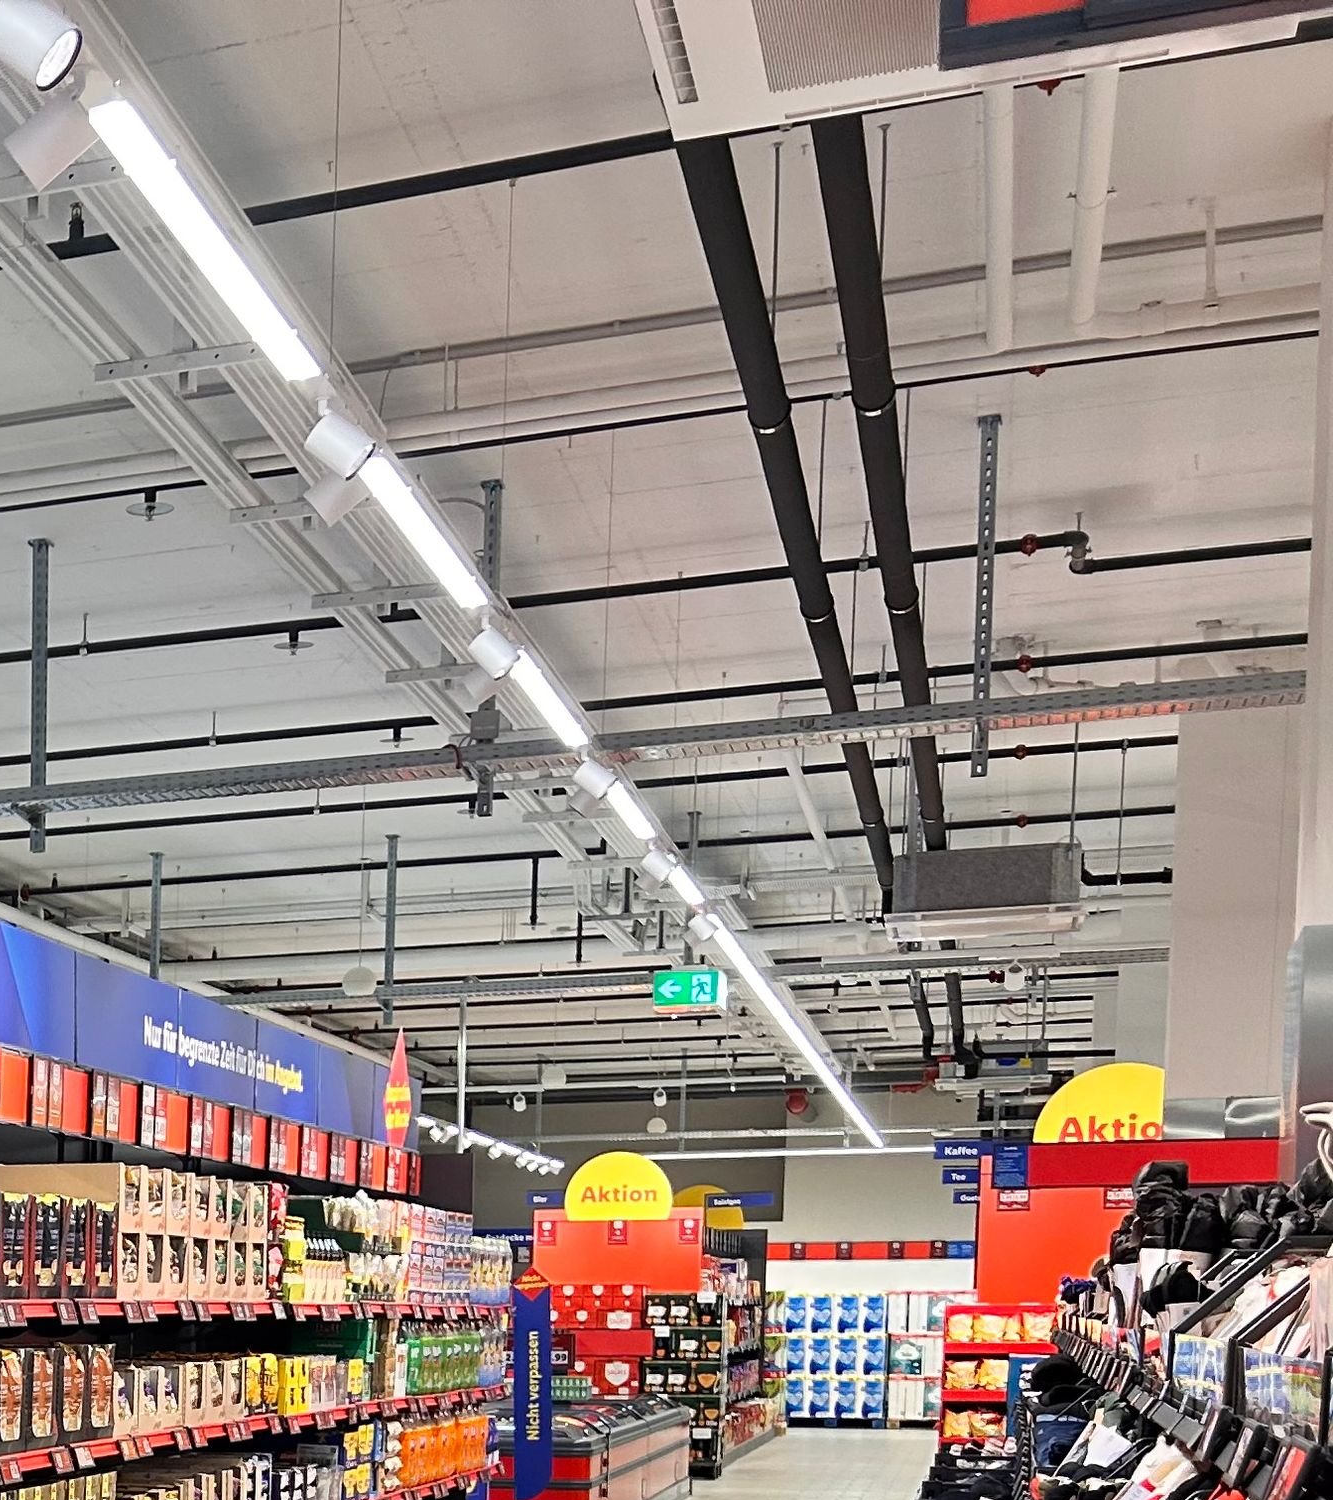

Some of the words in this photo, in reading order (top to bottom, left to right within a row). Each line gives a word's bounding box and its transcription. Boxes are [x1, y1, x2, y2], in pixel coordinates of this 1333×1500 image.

[143, 1015, 163, 1049] Nur
[163, 1020, 178, 1053] für
[178, 1025, 220, 1068] begrenzte
[220, 1041, 235, 1072] Zeit
[235, 1049, 248, 1073] für
[248, 1049, 266, 1079] Dich
[1059, 1113, 1162, 1144] Aktio
[944, 1146, 978, 1157] Kaffee
[951, 1172, 966, 1181] Tee
[581, 1184, 658, 1204] Aktion
[528, 1330, 542, 1401] verpassen
[525, 1402, 540, 1441] Nicht
